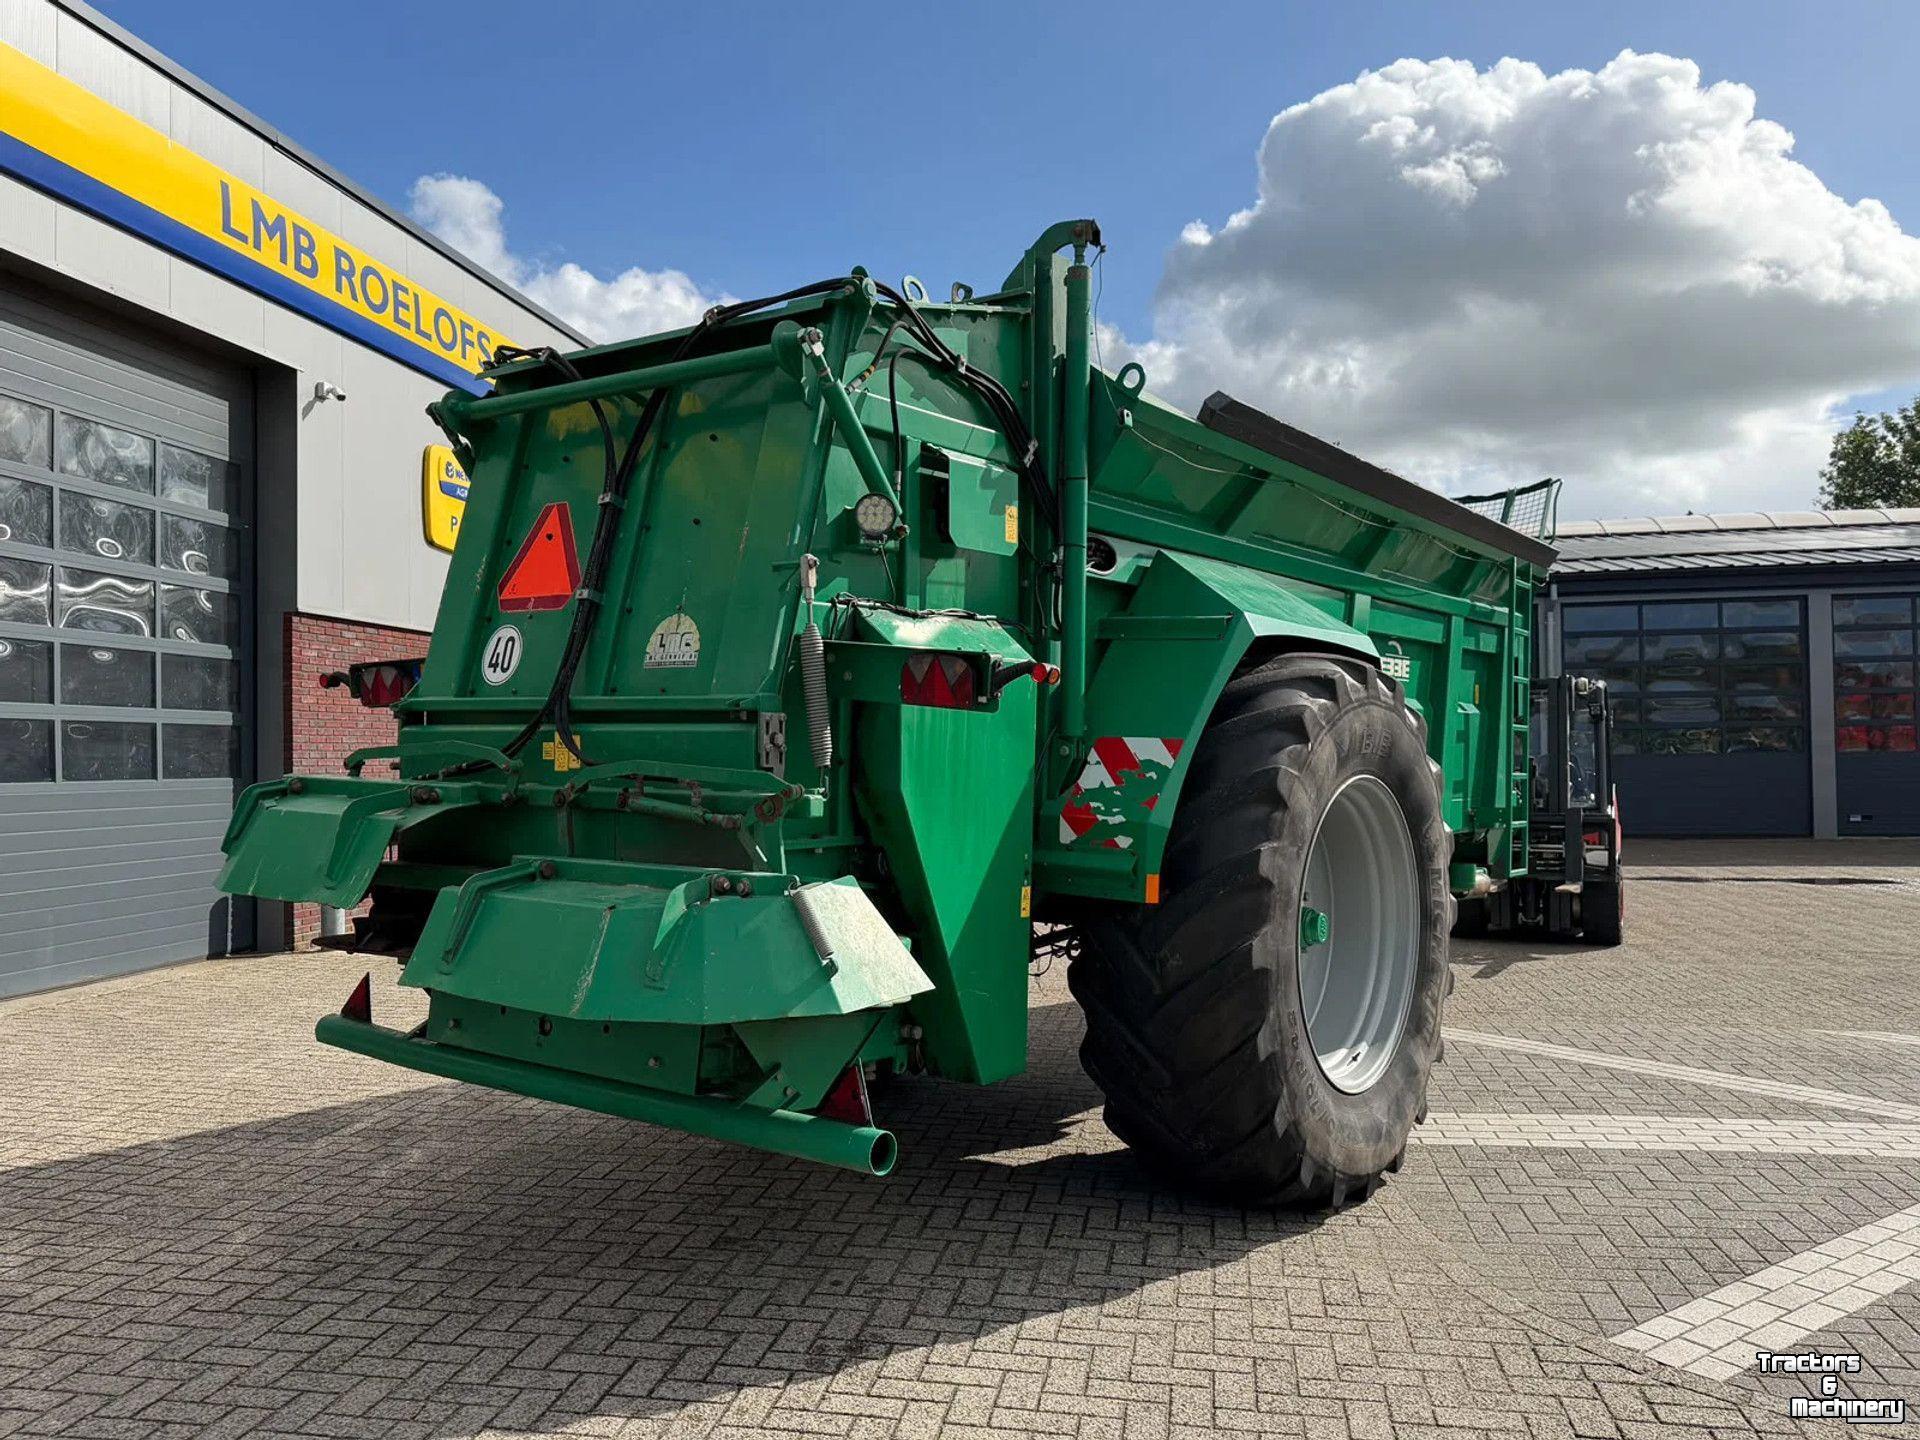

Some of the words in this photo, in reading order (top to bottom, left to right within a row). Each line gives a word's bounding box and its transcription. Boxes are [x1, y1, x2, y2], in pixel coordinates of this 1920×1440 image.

[219, 179, 320, 279] LMB
[333, 244, 494, 367] ROELOFS
[487, 636, 516, 674] 40
